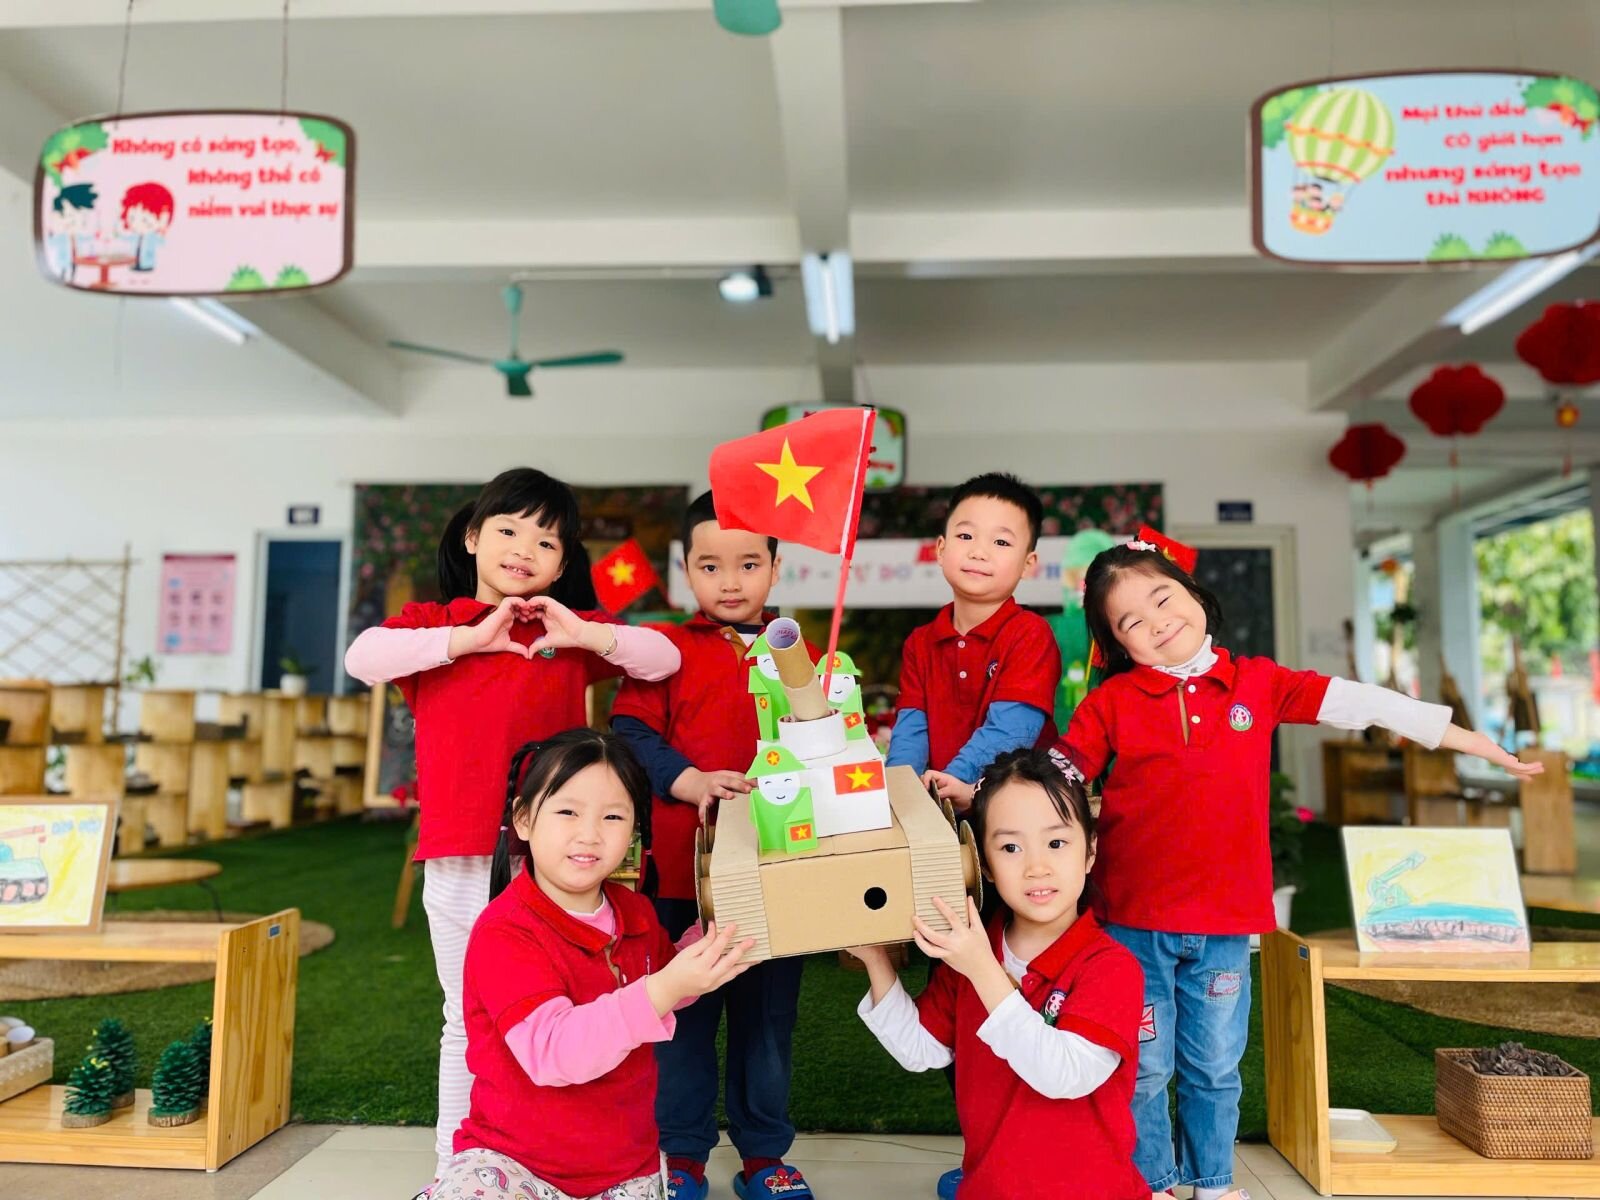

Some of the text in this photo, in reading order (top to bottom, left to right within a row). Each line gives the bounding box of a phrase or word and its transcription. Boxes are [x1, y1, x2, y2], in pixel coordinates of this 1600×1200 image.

[1403, 106, 1438, 123] Mọi
[113, 138, 174, 160] Không
[182, 135, 203, 152] có
[209, 136, 256, 158] sáng
[1523, 132, 1562, 149] hạn
[300, 167, 321, 184] có
[1385, 160, 1582, 185] nhưng sáng tạo
[1467, 187, 1546, 205] KHÔNG
